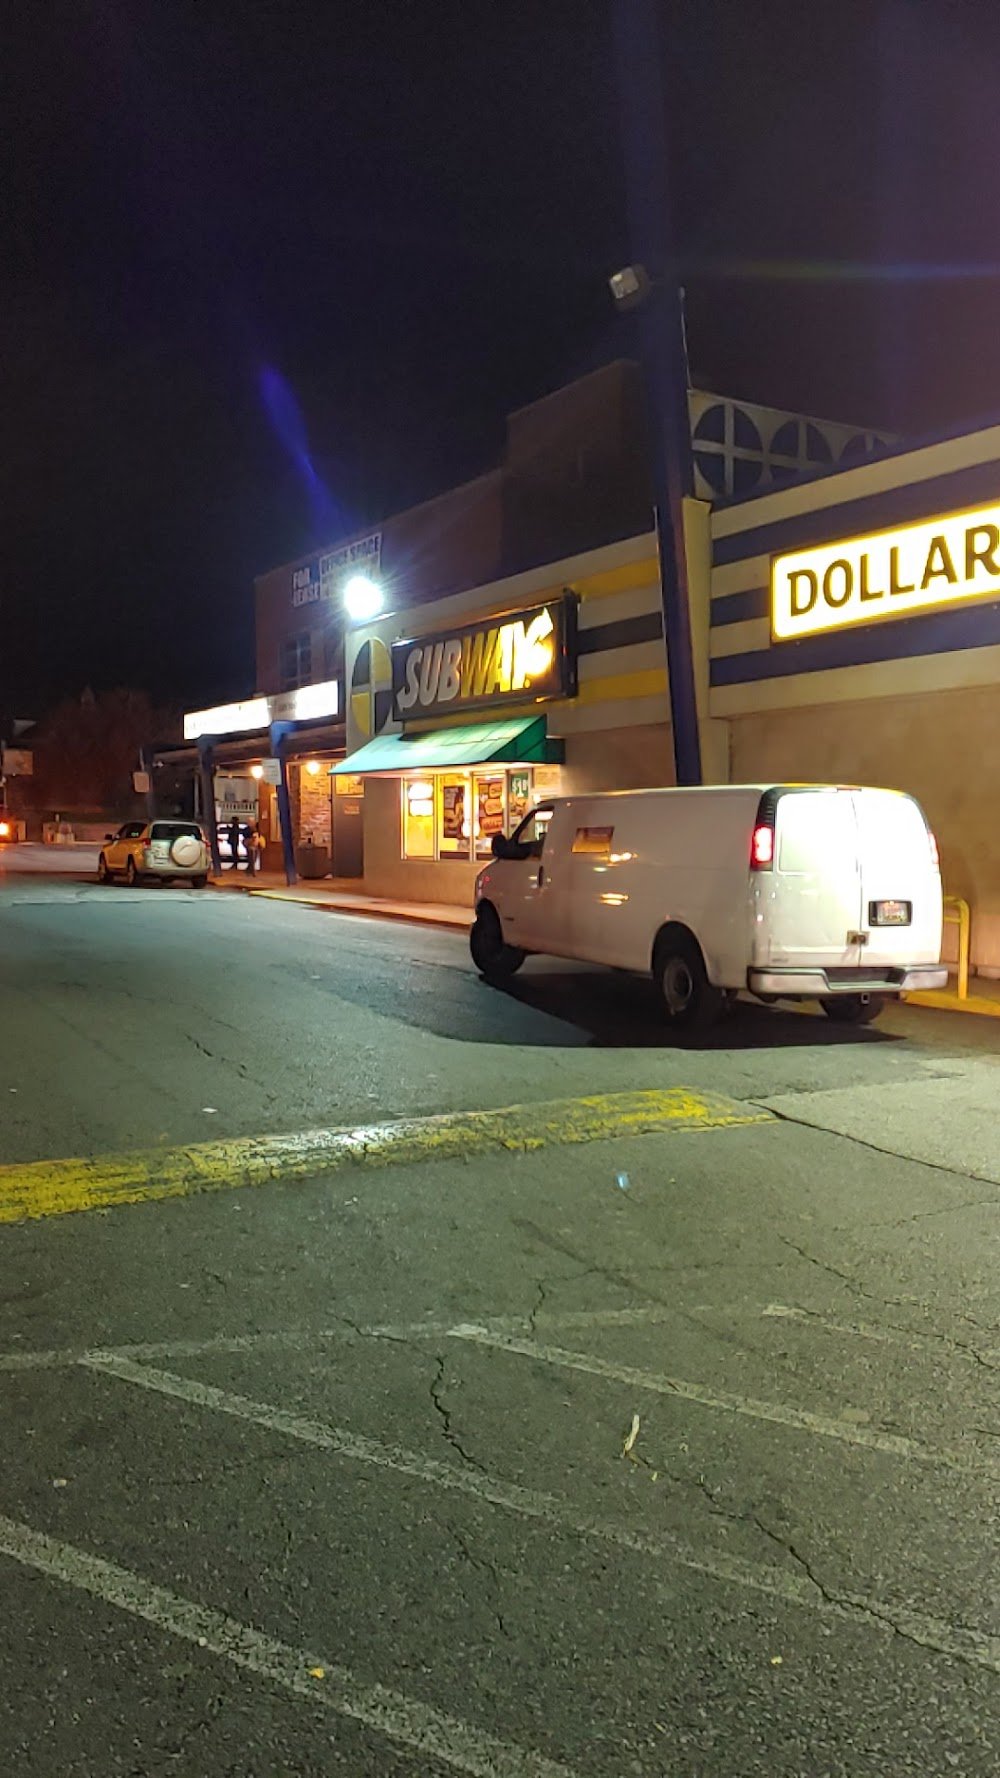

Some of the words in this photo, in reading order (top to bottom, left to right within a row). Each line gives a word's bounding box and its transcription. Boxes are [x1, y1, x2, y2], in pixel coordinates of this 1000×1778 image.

[293, 567, 310, 590] FOR
[787, 523, 1000, 617] DOLLAR
[396, 606, 555, 709] SUBWAY
